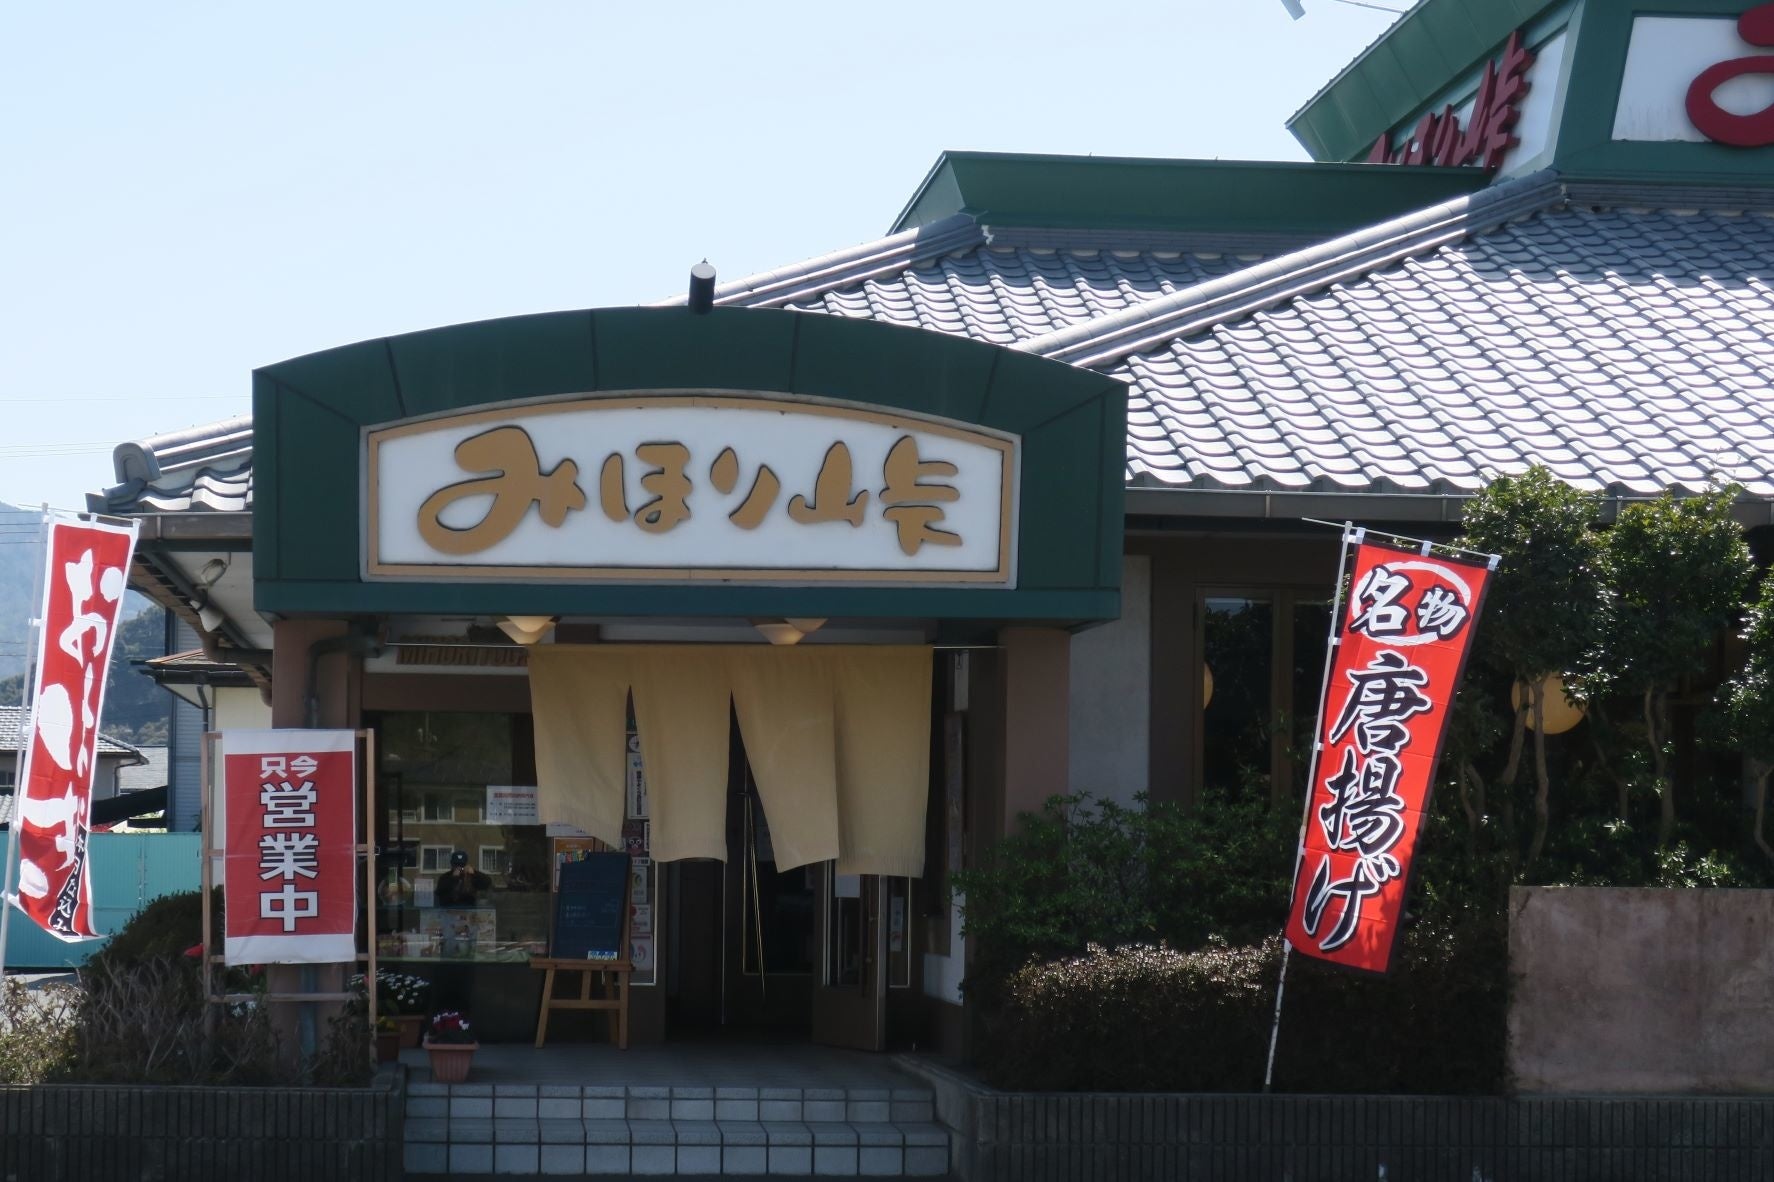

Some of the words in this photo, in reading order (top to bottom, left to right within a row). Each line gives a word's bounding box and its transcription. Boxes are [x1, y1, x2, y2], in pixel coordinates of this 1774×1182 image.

[1350, 566, 1470, 640] 名物
[260, 755, 318, 779] 只今
[1302, 649, 1431, 951] 唐揚げ
[258, 781, 319, 932] 営業中
